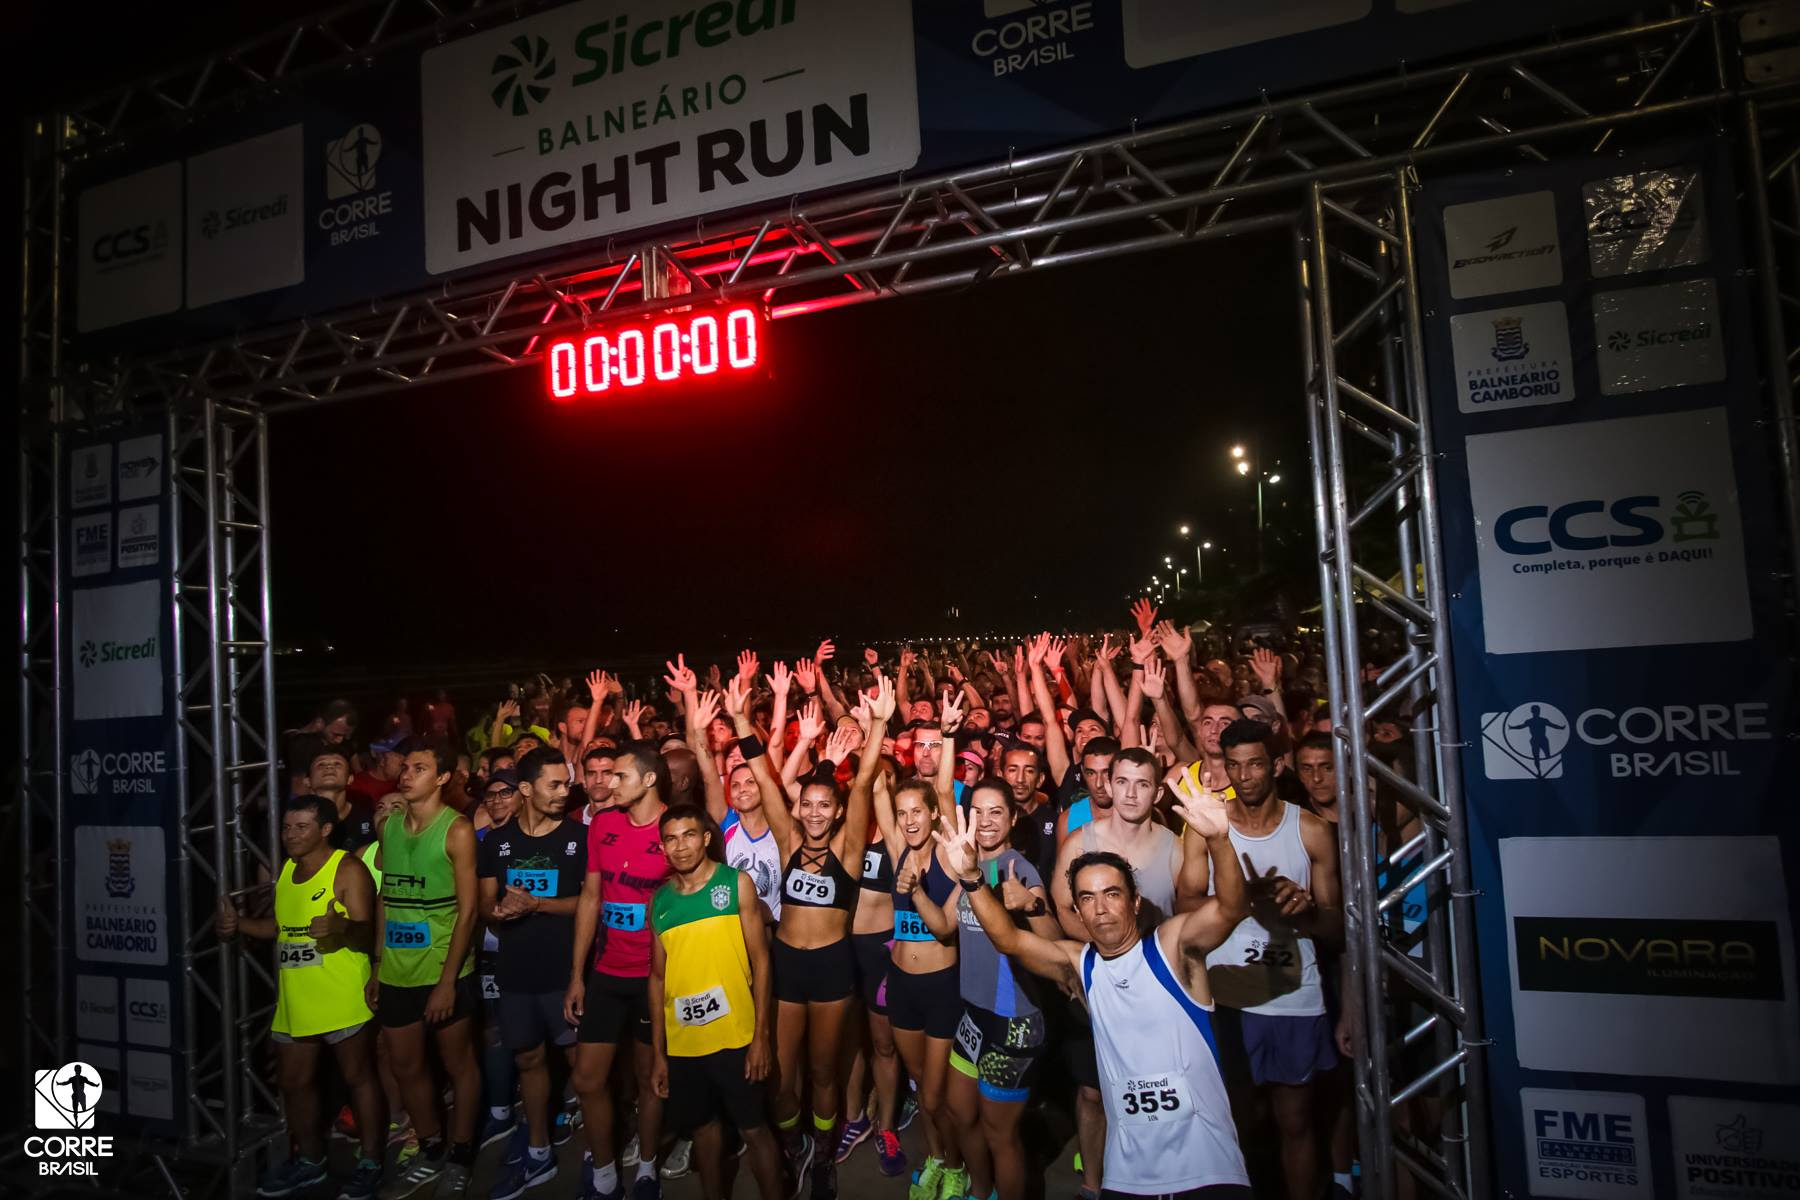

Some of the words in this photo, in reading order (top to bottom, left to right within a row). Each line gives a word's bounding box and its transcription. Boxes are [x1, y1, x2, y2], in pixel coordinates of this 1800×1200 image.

[970, 3, 1095, 58] CORRE
[992, 41, 1075, 77] BRASIL
[537, 74, 747, 155] BALNEÁRIO
[456, 141, 681, 252] NIGHT
[697, 93, 870, 193] RUN
[224, 194, 288, 230] Sicredi
[317, 191, 392, 230] CORRE
[93, 224, 151, 264] CCS
[330, 221, 380, 246] BRASIL
[1636, 323, 1712, 348] Sicredi
[551, 308, 757, 397] 00:00:00
[1494, 495, 1665, 555] CCS
[1513, 559, 1585, 574] Completa,
[1589, 554, 1641, 569] porque
[1659, 547, 1713, 562] DAQUI!
[101, 638, 156, 662] Sicredi
[1576, 702, 1772, 745] CORRE
[102, 751, 166, 775] CORRE
[1610, 749, 1741, 778] BRASIL
[113, 778, 156, 794] BRASIL
[793, 879, 829, 898] 079
[807, 875, 826, 884] Sicredi
[605, 911, 634, 926] 721
[388, 929, 425, 944] 1299
[281, 949, 315, 963] 045
[1244, 948, 1294, 967] 252
[1538, 935, 1757, 967] NOVARA
[129, 1001, 158, 1017] CCS
[683, 998, 720, 1021] 354
[960, 1022, 978, 1051] 069
[1137, 1077, 1168, 1090] Sicredi
[1123, 1088, 1180, 1115] 355
[1534, 1109, 1634, 1143] FME
[1539, 1166, 1639, 1186] ESPORTES
